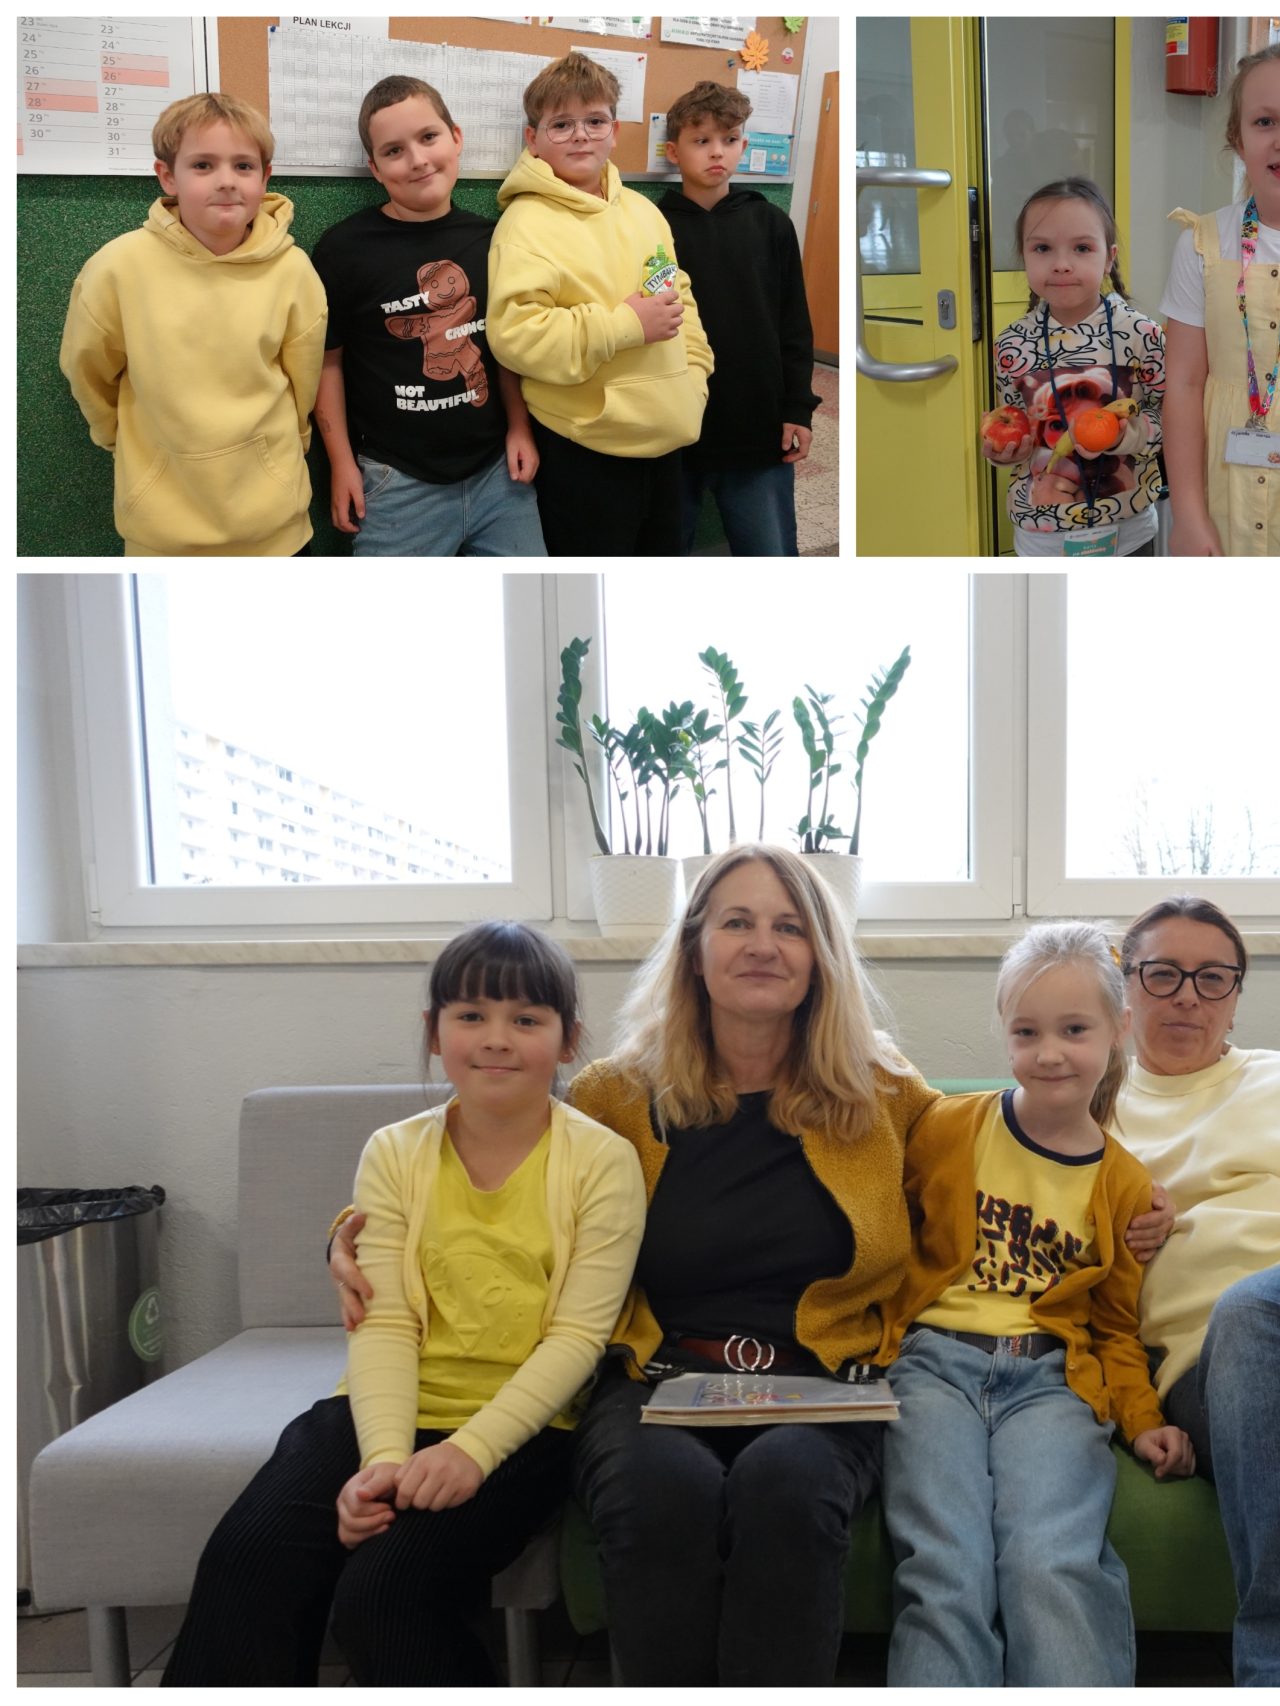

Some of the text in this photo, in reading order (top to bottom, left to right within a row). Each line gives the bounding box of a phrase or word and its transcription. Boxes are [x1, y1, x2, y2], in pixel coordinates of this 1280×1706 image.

[20, 16, 34, 26] 23
[293, 16, 352, 31] PLAN LEKCJI
[100, 24, 114, 34] 23
[22, 32, 36, 43] 24
[101, 40, 115, 50] 24
[23, 49, 38, 59] 25
[102, 56, 116, 65] 25
[25, 65, 40, 75] 26
[103, 71, 117, 81] 26
[26, 82, 40, 91] 27
[104, 86, 117, 96] 27
[27, 98, 42, 107] 28
[105, 102, 119, 112] 28
[29, 113, 43, 123] 29
[106, 117, 120, 127] 29
[30, 129, 44, 138] 30
[107, 132, 120, 141] 30
[108, 147, 120, 156] 31
[380, 291, 430, 314] TASTY
[394, 385, 426, 398] NOT
[396, 389, 480, 412] BEAUTIFUL
